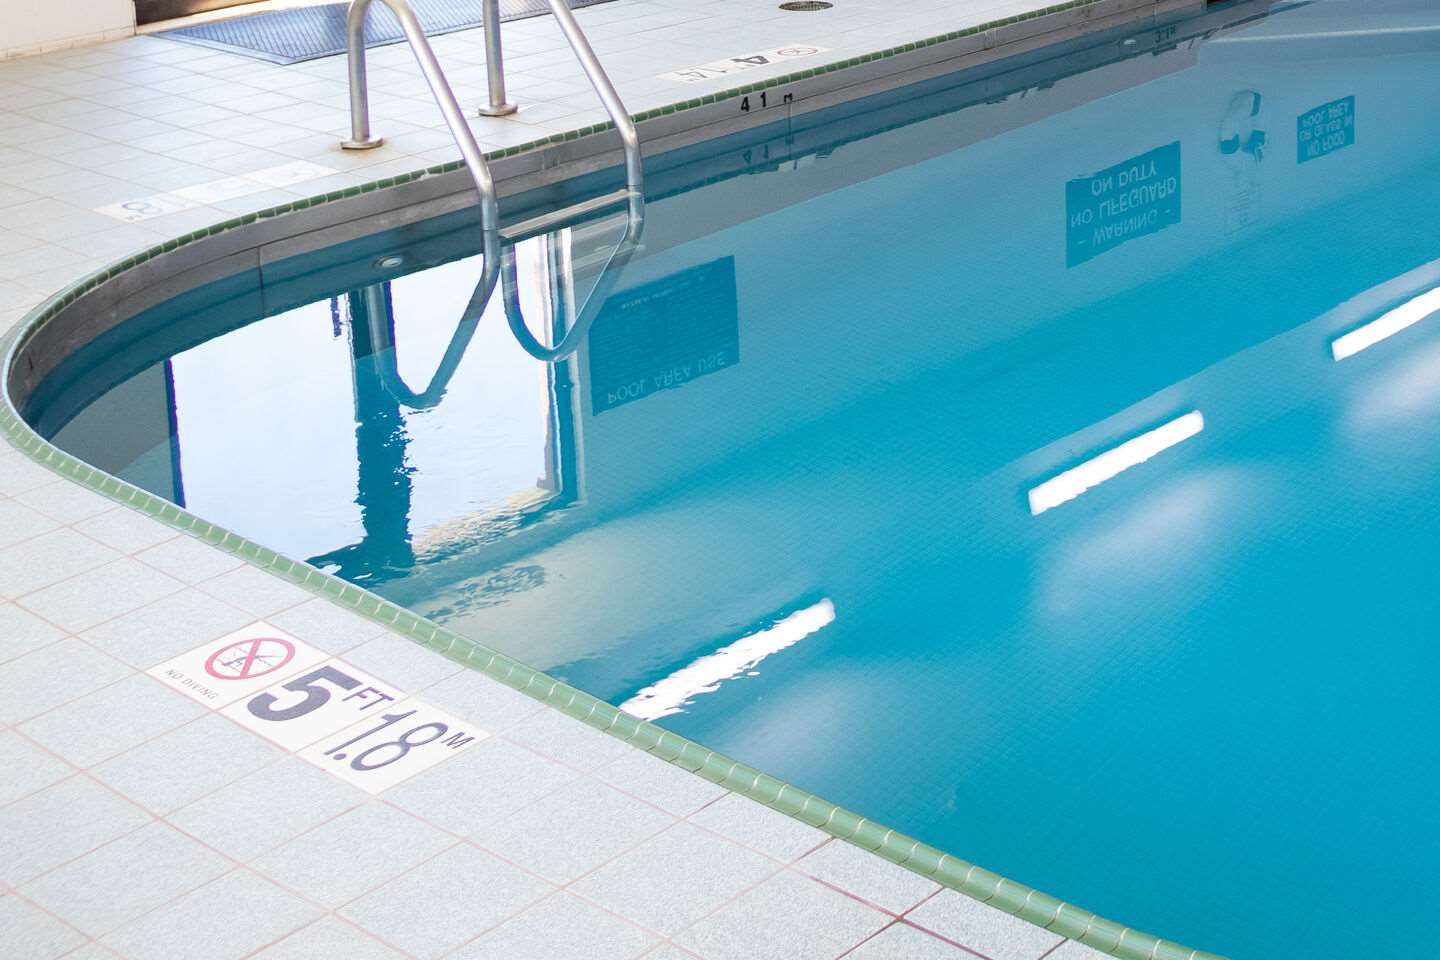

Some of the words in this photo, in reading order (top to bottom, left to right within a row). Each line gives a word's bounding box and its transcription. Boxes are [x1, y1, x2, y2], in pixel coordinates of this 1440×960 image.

[247, 665, 363, 722] 5
[341, 686, 395, 711] FT
[323, 709, 449, 772] 1.8
